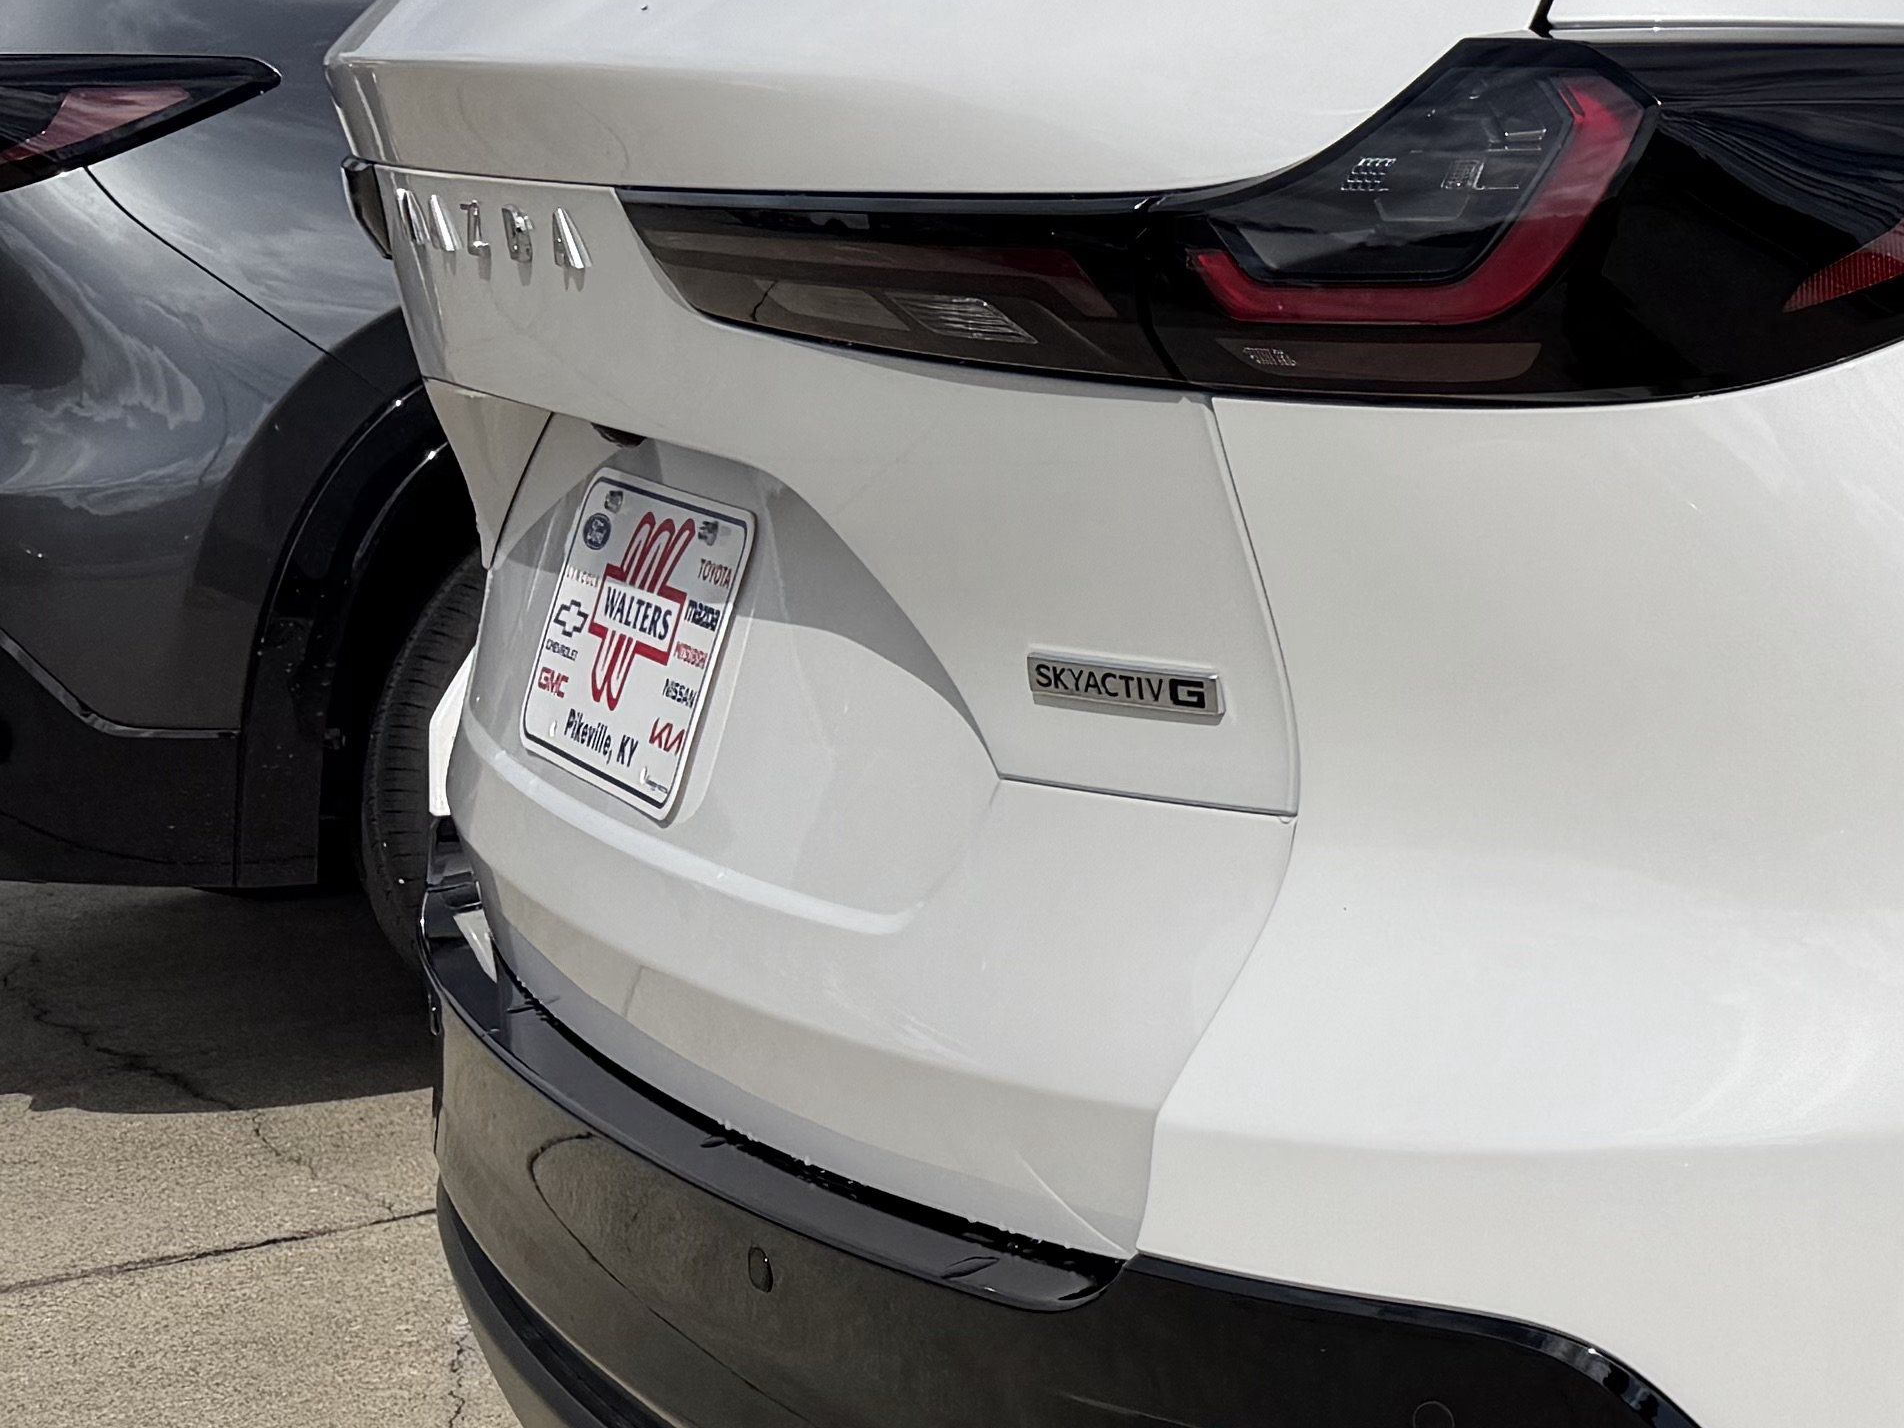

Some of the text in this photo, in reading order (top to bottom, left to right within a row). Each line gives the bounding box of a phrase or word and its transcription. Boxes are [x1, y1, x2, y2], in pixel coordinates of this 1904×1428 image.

[697, 558, 733, 590] TOYOTA
[603, 584, 674, 642] WALTERS
[537, 666, 570, 699] GMC
[563, 708, 640, 768] Pikeville, KY
